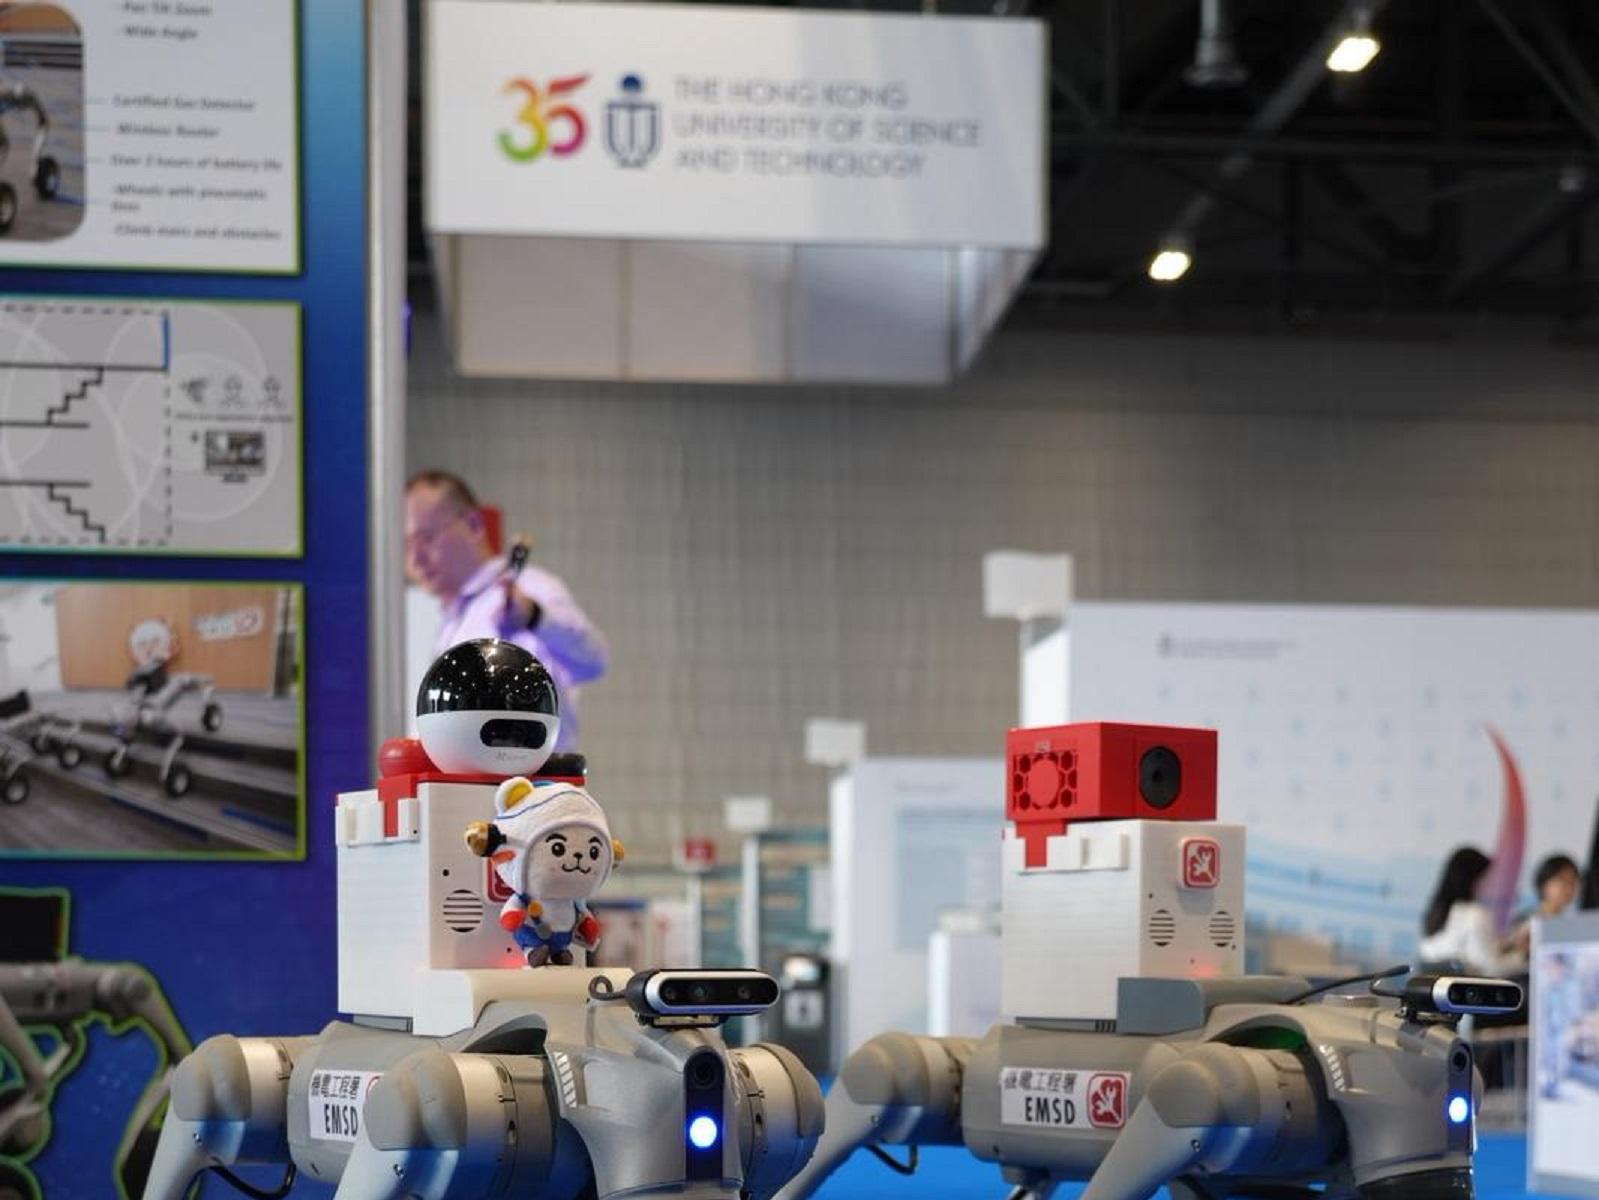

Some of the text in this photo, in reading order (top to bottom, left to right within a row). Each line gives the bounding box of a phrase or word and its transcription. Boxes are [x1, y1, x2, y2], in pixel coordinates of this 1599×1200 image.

[124, 25, 198, 41] Wide Angle
[674, 77, 909, 109] THE HONG KONG
[117, 122, 219, 138] Wireless Router
[498, 73, 592, 163] 35
[673, 111, 981, 147] UNIVERSITY OF SCIENCE
[111, 154, 141, 166] Over
[157, 155, 193, 167] hours
[197, 156, 211, 167] of
[213, 156, 259, 172] battery
[264, 157, 282, 170] life
[674, 148, 927, 179] AND TECHNOLOGY
[168, 184, 194, 197] with
[157, 225, 191, 238] stairs
[194, 226, 216, 239] and
[221, 227, 282, 240] obstacles
[324, 1103, 358, 1137] EMSD
[1025, 1096, 1075, 1125] EMSD
